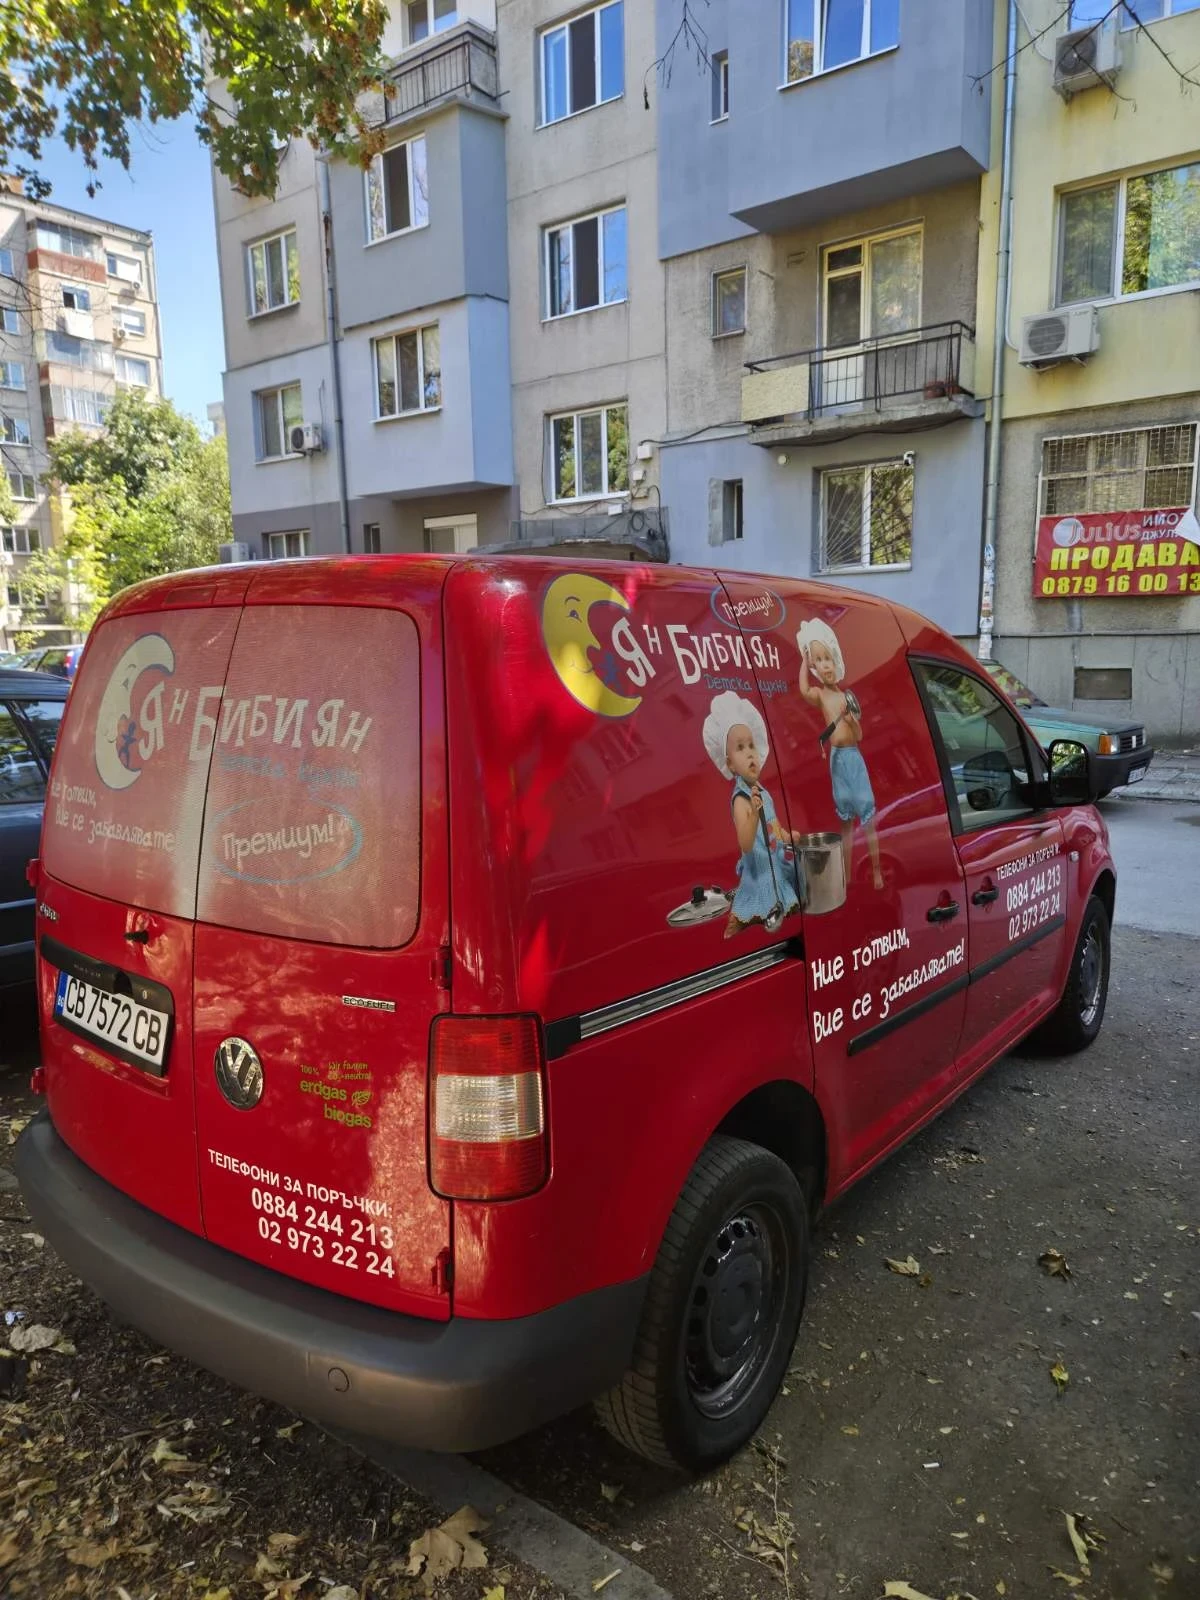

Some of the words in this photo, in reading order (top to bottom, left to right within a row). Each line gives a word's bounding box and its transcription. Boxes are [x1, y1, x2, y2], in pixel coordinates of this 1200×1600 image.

[1141, 528, 1178, 541] ДЖУЛ
[1143, 511, 1185, 527] ИМО
[1050, 541, 1200, 572] ПРОДАВА
[1042, 576, 1097, 595] 0879
[1105, 574, 1131, 593] 16
[1138, 572, 1168, 592] 00
[1177, 572, 1200, 591] 13
[72, 813, 84, 831] се
[222, 813, 335, 872] Премиум!
[996, 856, 1028, 880] ТЕЛЕФОНИ
[1028, 853, 1036, 867] ЗА
[1006, 880, 1029, 912] 0884
[1030, 871, 1045, 900] 244
[1047, 864, 1061, 891] 213
[1008, 914, 1020, 941] 02
[1022, 904, 1038, 933] 973
[1039, 897, 1049, 922] 22
[1050, 891, 1060, 917] 24
[811, 955, 845, 991] Ние
[852, 928, 911, 971] готвим,
[813, 1007, 844, 1043] Вие
[852, 991, 872, 1021] се
[879, 938, 965, 1019] забавлявате!
[87, 987, 132, 1043] 7572
[300, 1080, 347, 1101] erdgas
[324, 1103, 372, 1129] biogas
[207, 1148, 280, 1187] ТЕЛЕФОНИ
[283, 1176, 303, 1196] ЗА
[306, 1183, 393, 1219] ПОРЪЧКИ:
[251, 1187, 299, 1223] 0884
[304, 1205, 344, 1237] 244
[350, 1219, 394, 1250] 213
[258, 1216, 282, 1245] 02
[287, 1227, 325, 1259] 973
[331, 1241, 359, 1270] 22
[366, 1251, 395, 1279] 24
